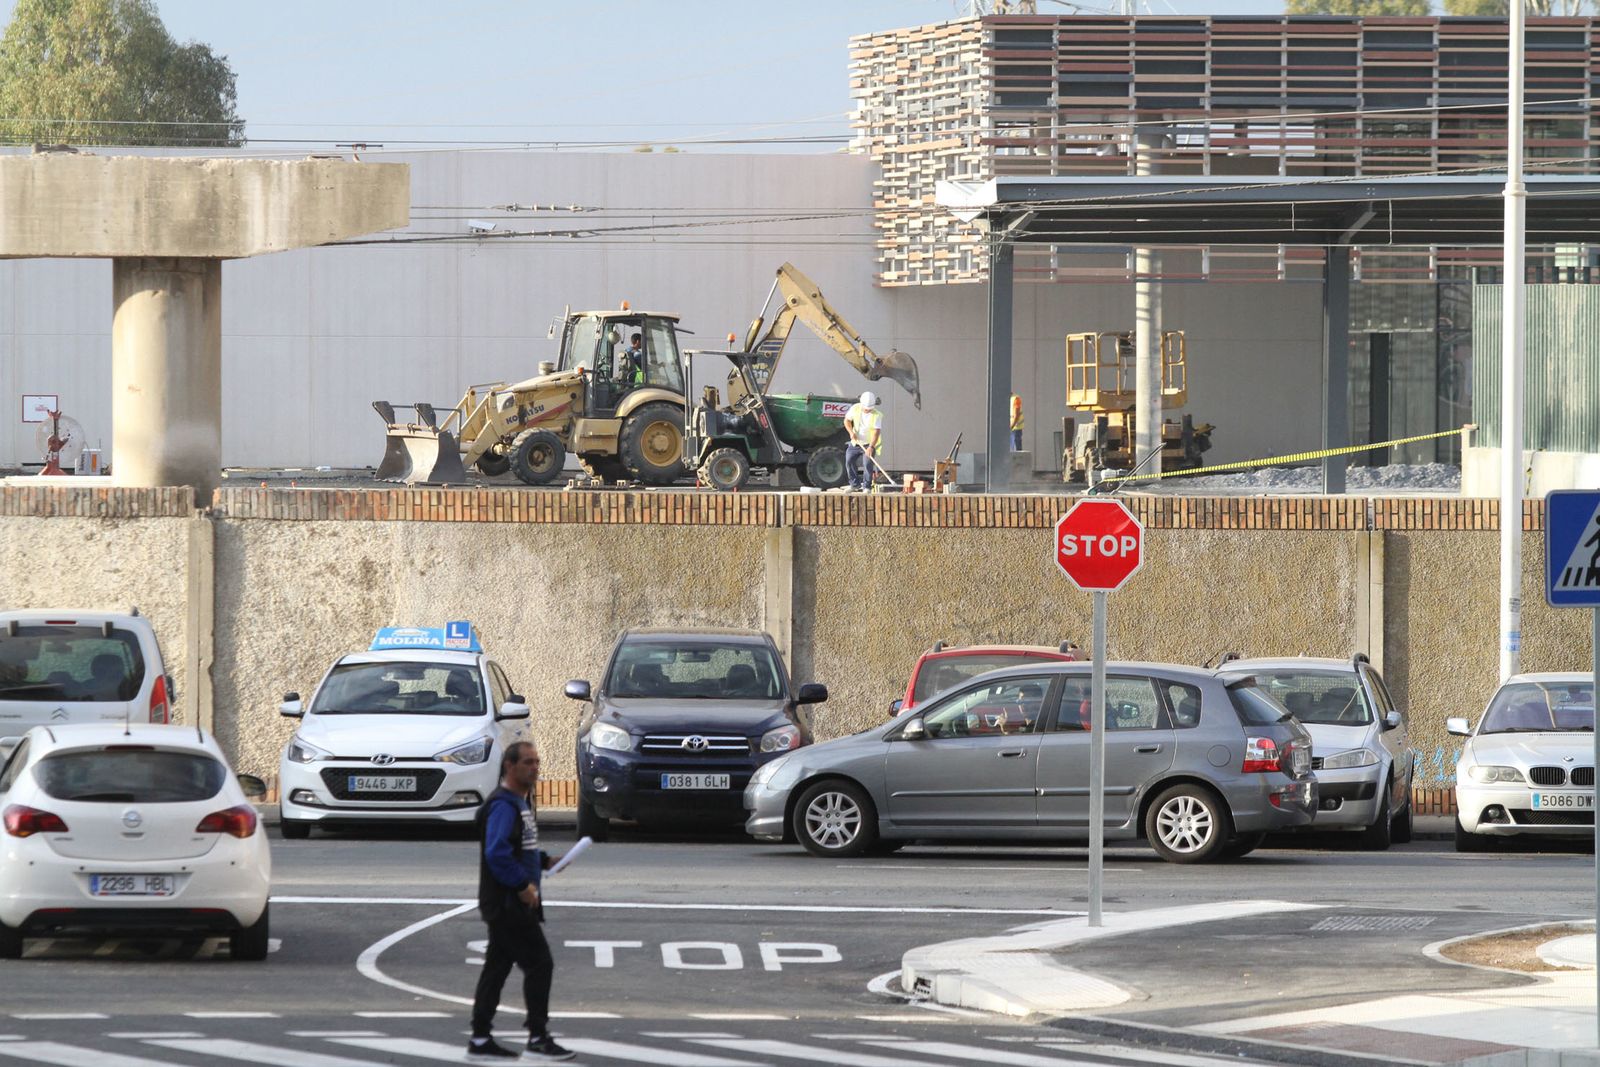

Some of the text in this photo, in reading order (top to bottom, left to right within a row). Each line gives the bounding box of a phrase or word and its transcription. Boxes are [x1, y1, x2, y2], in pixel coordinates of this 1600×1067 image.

[1061, 534, 1137, 558] STOP
[452, 624, 464, 637] L
[379, 637, 440, 645] MOLINA
[357, 778, 413, 790] 9446 JKP
[669, 775, 727, 787] 0381 GLH
[1542, 795, 1595, 807] 5086 DW
[101, 876, 170, 892] 2296 HBL
